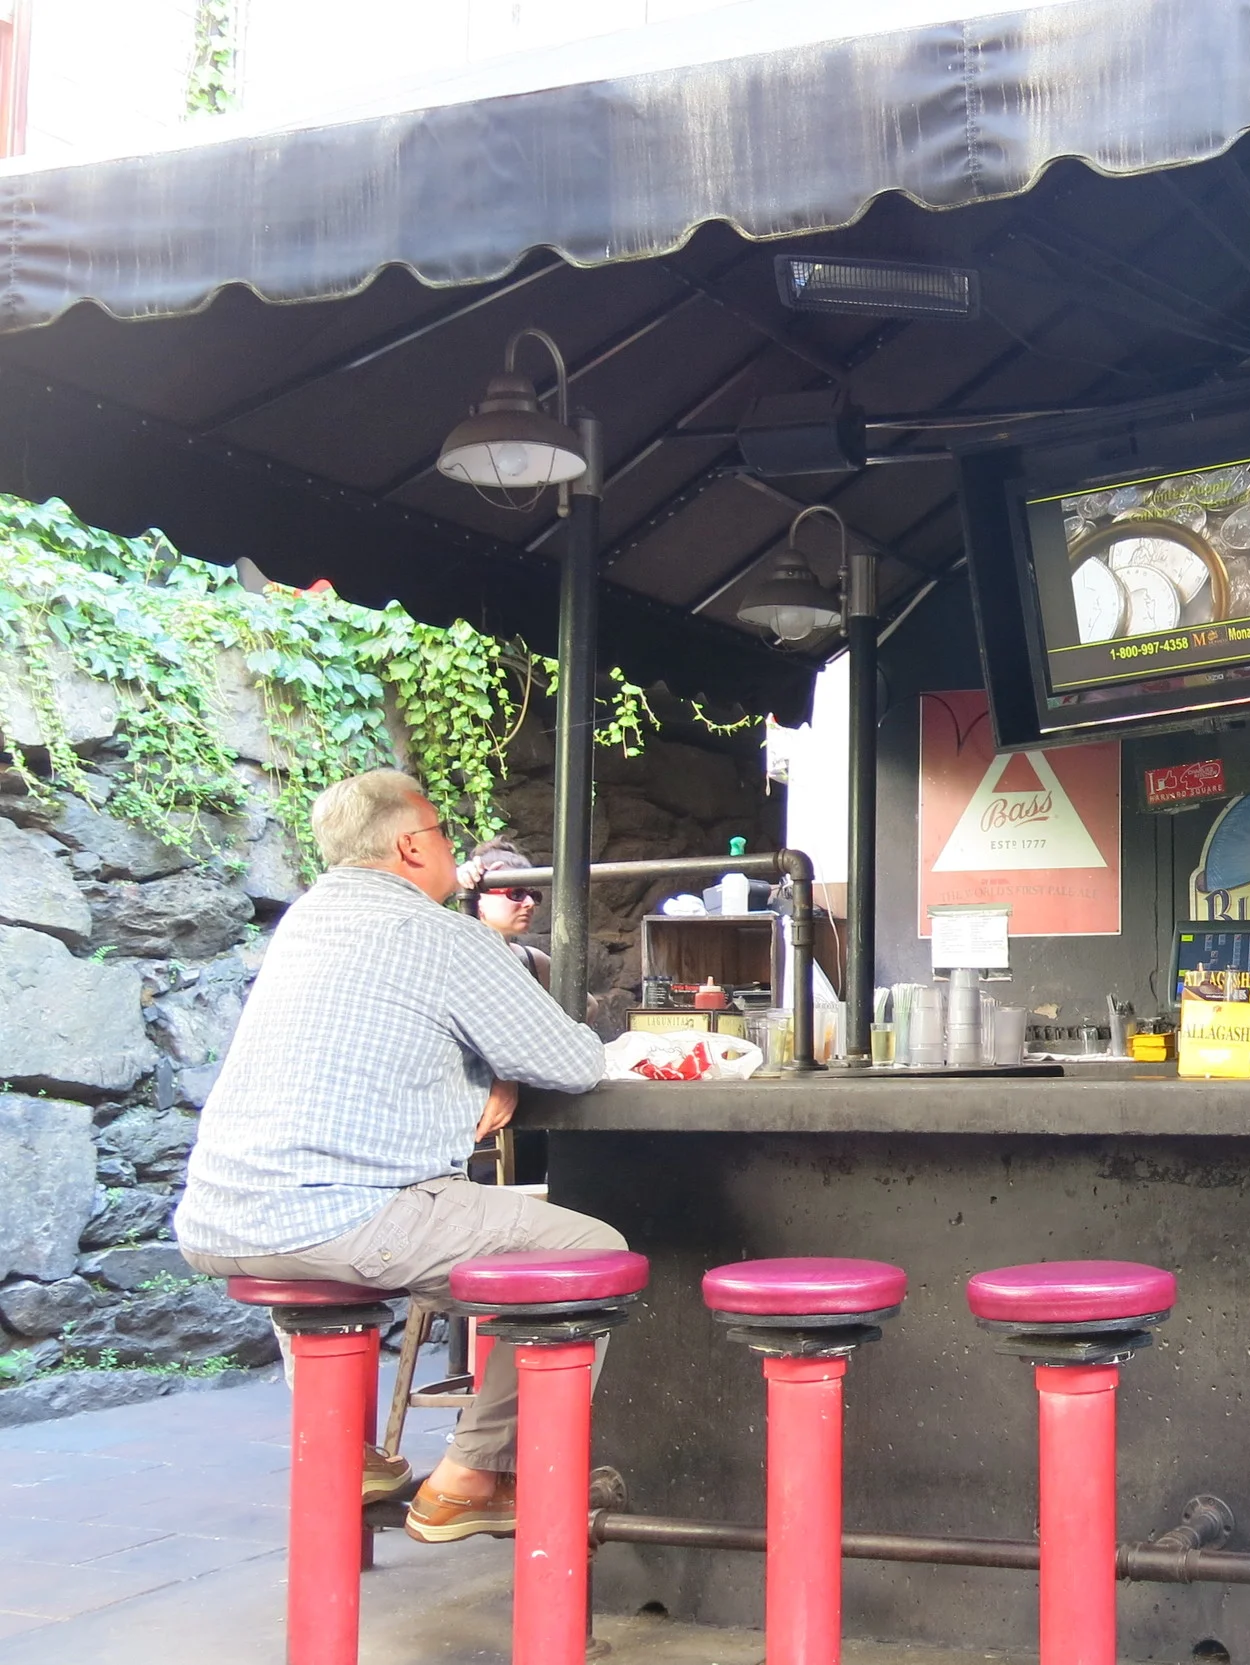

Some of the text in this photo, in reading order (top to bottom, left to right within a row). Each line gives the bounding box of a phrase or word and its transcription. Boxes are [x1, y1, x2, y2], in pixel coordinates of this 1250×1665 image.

[1110, 636, 1189, 660] 1-800-997-4358
[1149, 784, 1224, 803] HARVARD SQUARE
[980, 790, 1053, 832] Bass
[1022, 839, 1047, 849] 1777
[1182, 1023, 1250, 1043] ALLAGASH
